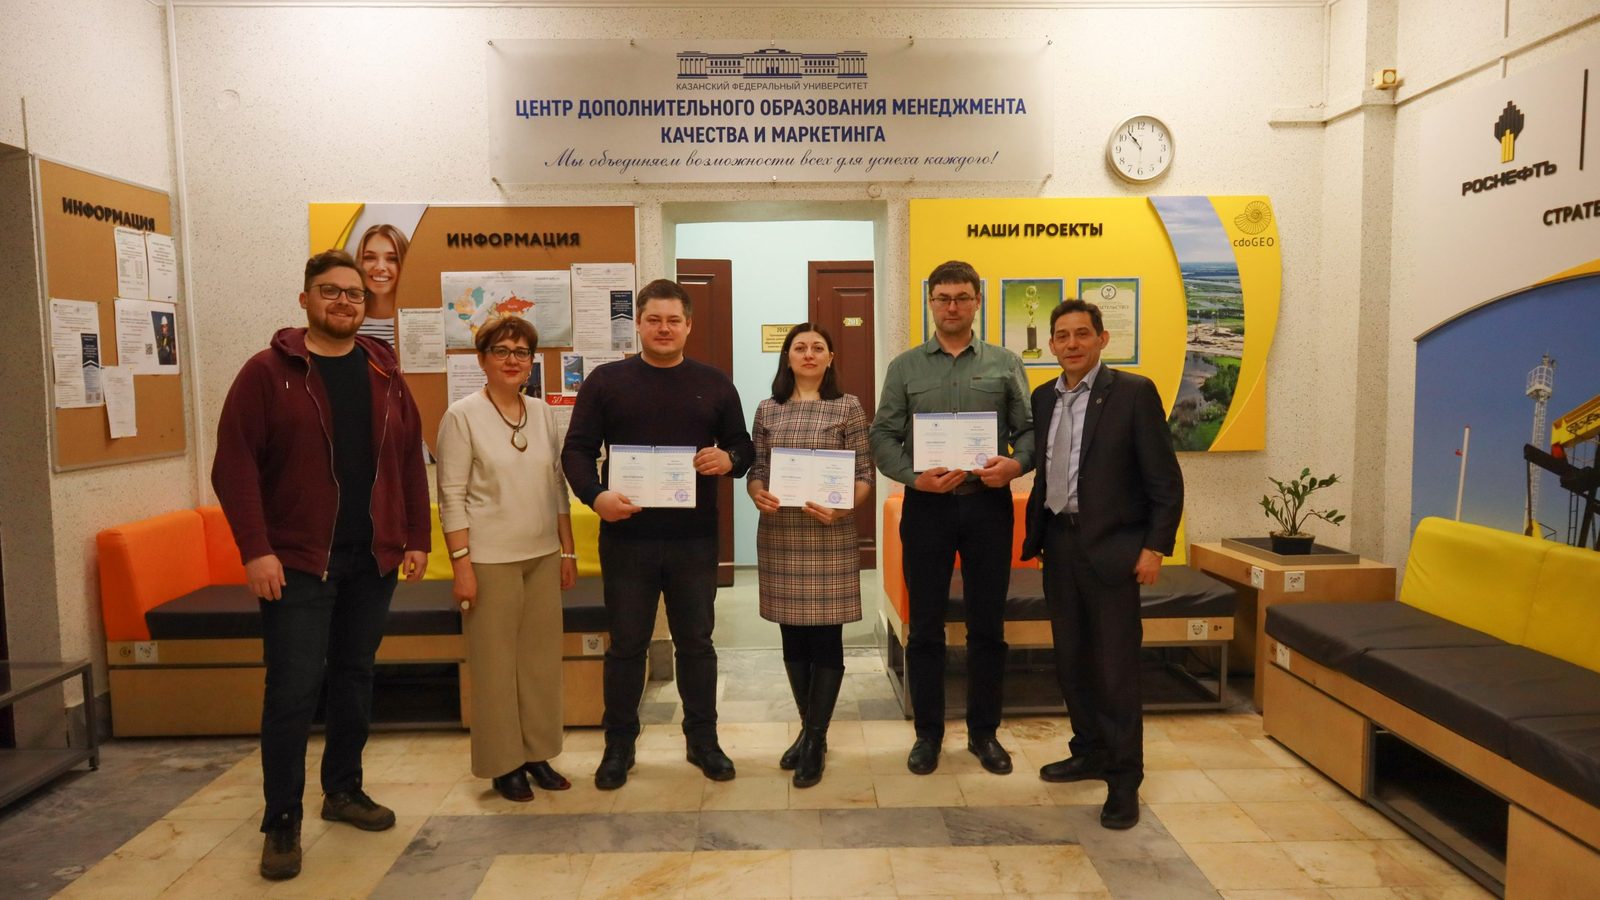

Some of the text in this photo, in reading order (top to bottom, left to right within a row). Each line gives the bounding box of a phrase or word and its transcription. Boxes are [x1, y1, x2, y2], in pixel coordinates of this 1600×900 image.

[676, 81, 868, 91] КАЗАНСКИЙ ФЕДЕРАЛЬНЫЙ УНИВЕРСИТЕТ
[515, 98, 1026, 118] ЦЕНТР ДОПОЛНИТЕЛЬНОГО ОБРАЗОВАНИЯ МЕНЕДЖМЕНТА
[661, 125, 886, 143] КАЧЕСТВА И МАРКЕТИНГА
[1138, 122, 1146, 130] 12
[544, 148, 999, 174] Мы объединяем возможности всех для успеха каждого!
[1462, 160, 1557, 196] РОСНЕФТЬ
[62, 197, 156, 232] ИНФОРМАЦИЯ
[1543, 200, 1600, 226] СТРАТЕ
[967, 223, 1103, 237] НАШИ ПРОЕКТЫ
[447, 233, 580, 248] ИНФОРМАЦИЯ
[1233, 237, 1274, 247] cdoGEO
